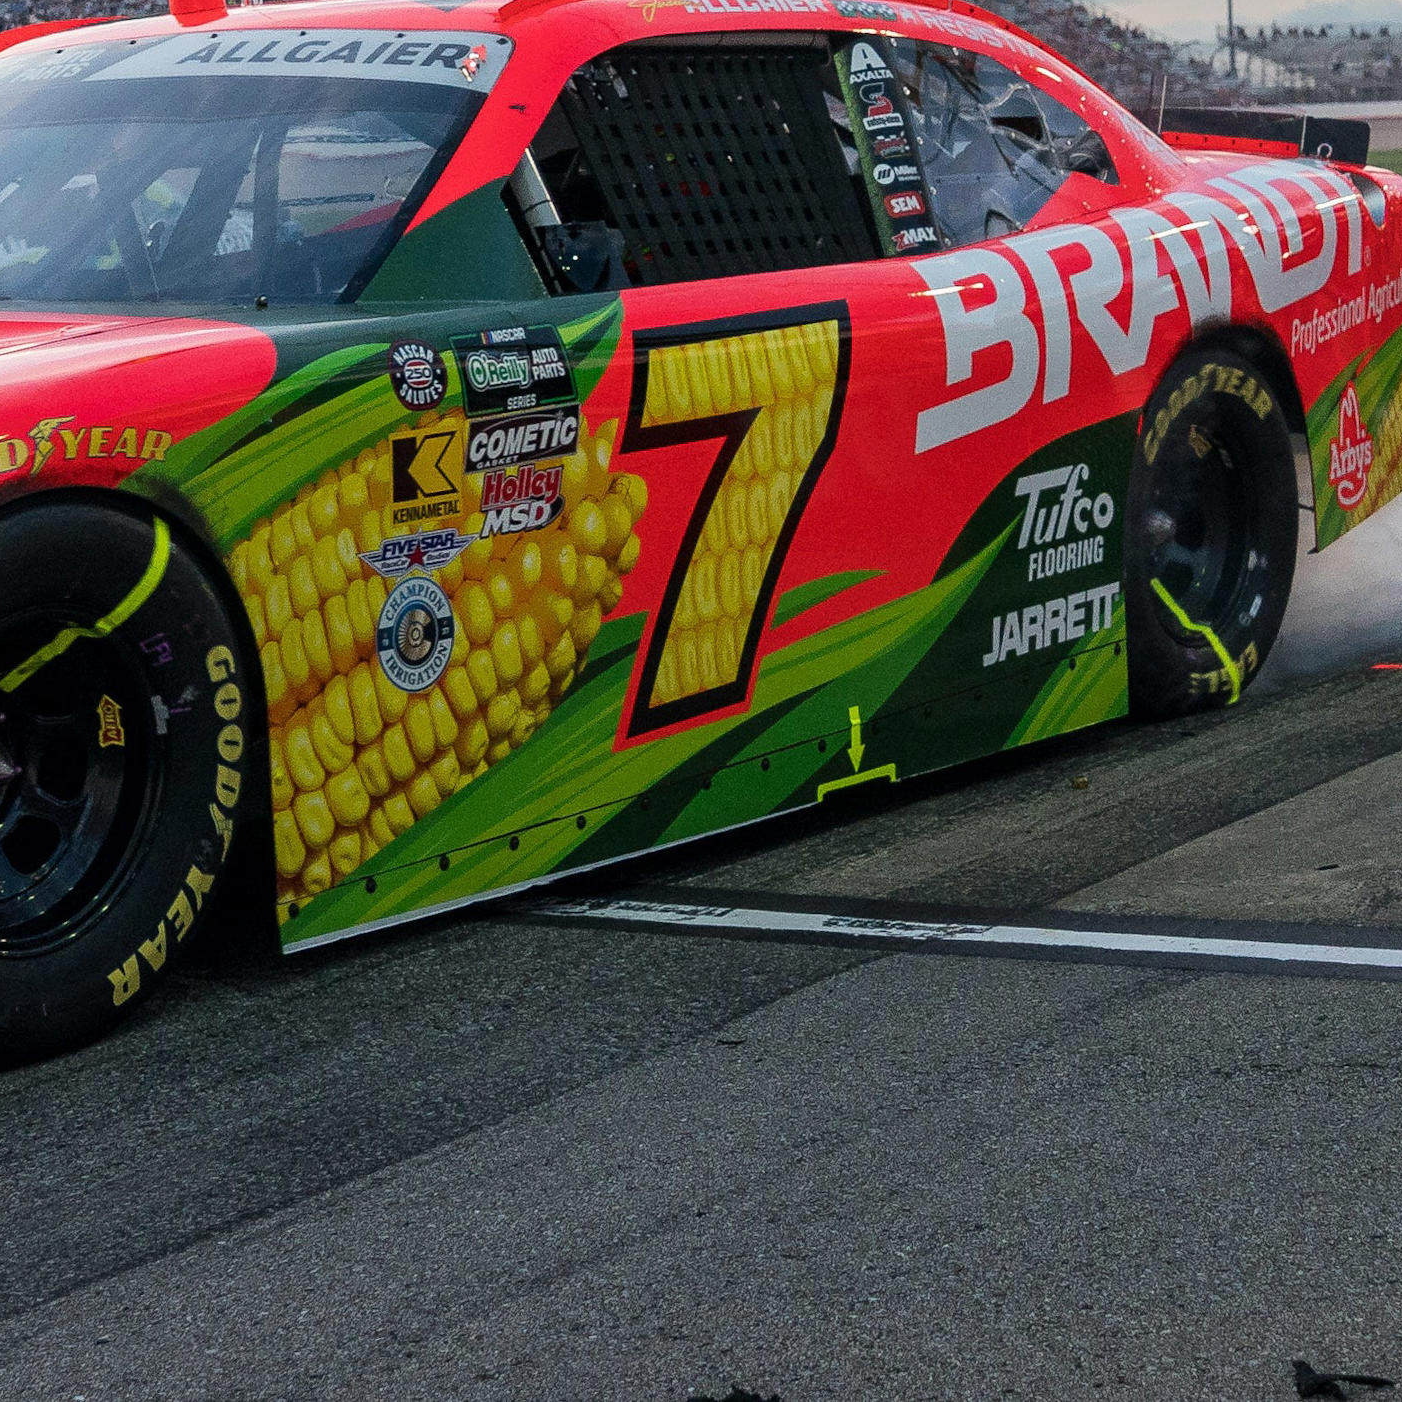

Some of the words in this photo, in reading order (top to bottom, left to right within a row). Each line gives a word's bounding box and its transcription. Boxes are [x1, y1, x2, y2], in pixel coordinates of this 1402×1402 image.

[175, 39, 473, 70] ALLGAIER
[849, 69, 894, 85] AXALTA
[890, 195, 921, 214] SEM
[911, 159, 1380, 455] BRANDT
[1291, 286, 1367, 358] Professional
[490, 327, 526, 344] NASCAR
[393, 344, 434, 366] NASCAR
[405, 367, 431, 379] 250
[467, 351, 530, 389] O'Reilly
[531, 347, 559, 364] AUTO
[532, 362, 566, 381] PARTS
[400, 380, 443, 405] SALUTES
[506, 394, 537, 410] SERIES
[469, 417, 578, 463] COMETIC
[1330, 429, 1372, 480] Arby's
[476, 456, 518, 470] GASKET
[482, 465, 563, 509] Holley
[393, 499, 460, 525] KENNAMETAL
[480, 500, 553, 538] MSD
[619, 300, 852, 741] 7
[1015, 463, 1114, 550] Tufco
[381, 539, 418, 561] FIVE
[420, 532, 456, 549] STAR
[1028, 535, 1104, 582] FLOORING
[385, 582, 446, 622] CHAMPION
[983, 581, 1120, 668] JARRETT
[385, 644, 450, 686] IRRIGATION
[104, 702, 121, 740] AERO
